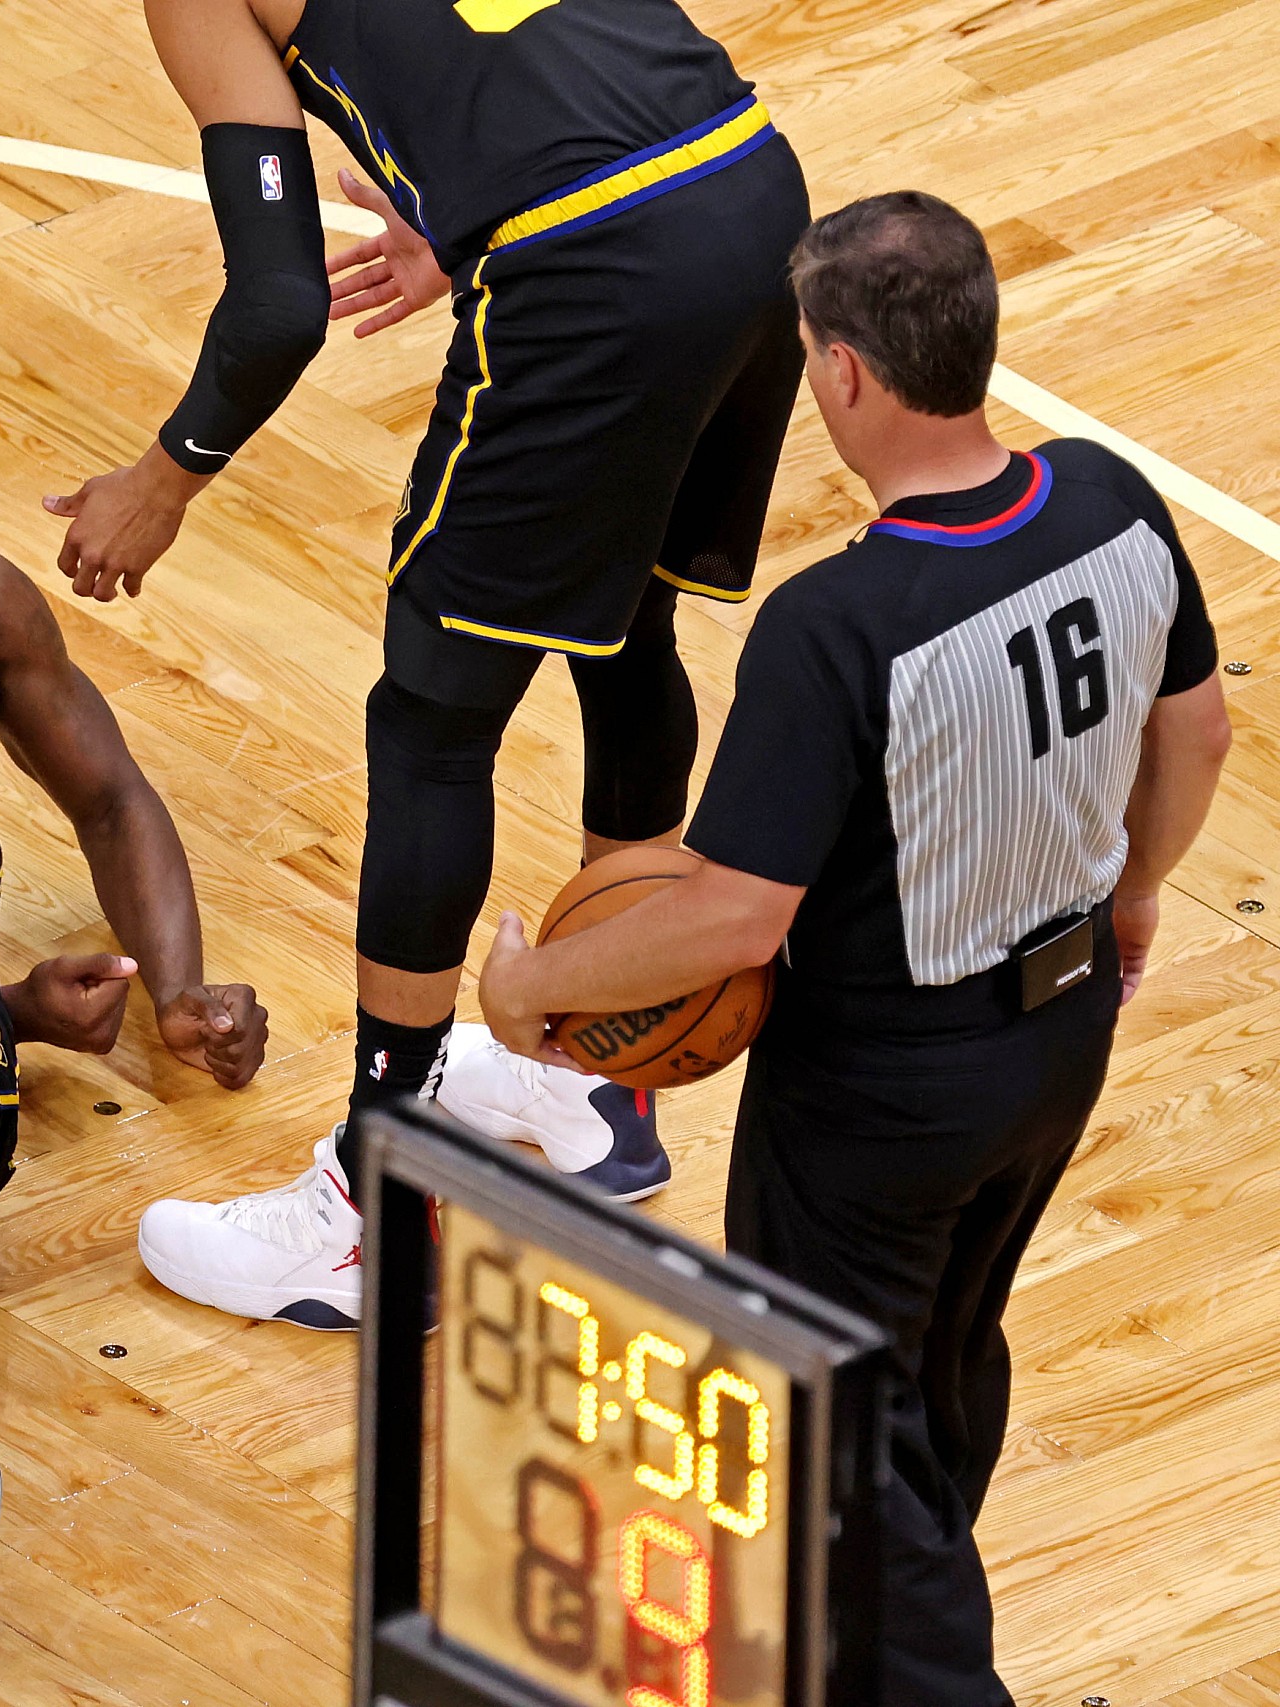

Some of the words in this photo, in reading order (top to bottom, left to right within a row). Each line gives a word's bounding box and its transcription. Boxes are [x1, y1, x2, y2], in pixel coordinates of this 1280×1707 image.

[1006, 596, 1109, 760] 16
[571, 981, 700, 1062] Wils
[539, 1281, 770, 1540] 7:50
